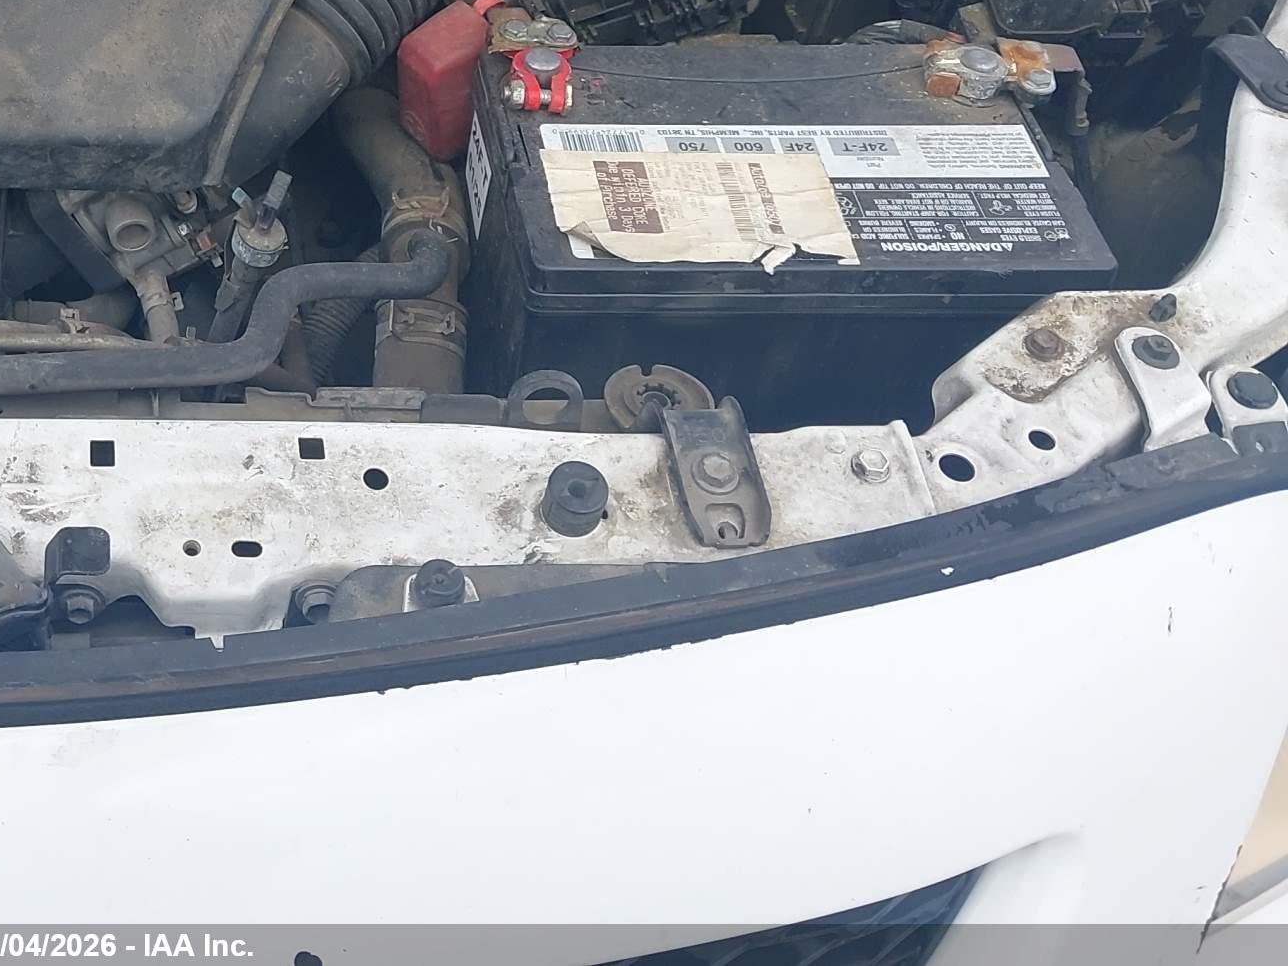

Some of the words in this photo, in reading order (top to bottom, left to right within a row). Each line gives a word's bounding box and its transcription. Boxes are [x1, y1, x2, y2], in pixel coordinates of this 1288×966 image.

[678, 142, 709, 152] 750
[734, 142, 764, 152] 600
[784, 142, 815, 152] 24F
[842, 142, 888, 152] 24F-T
[950, 232, 966, 240] NO
[880, 242, 1003, 252] DANGER/POISON
